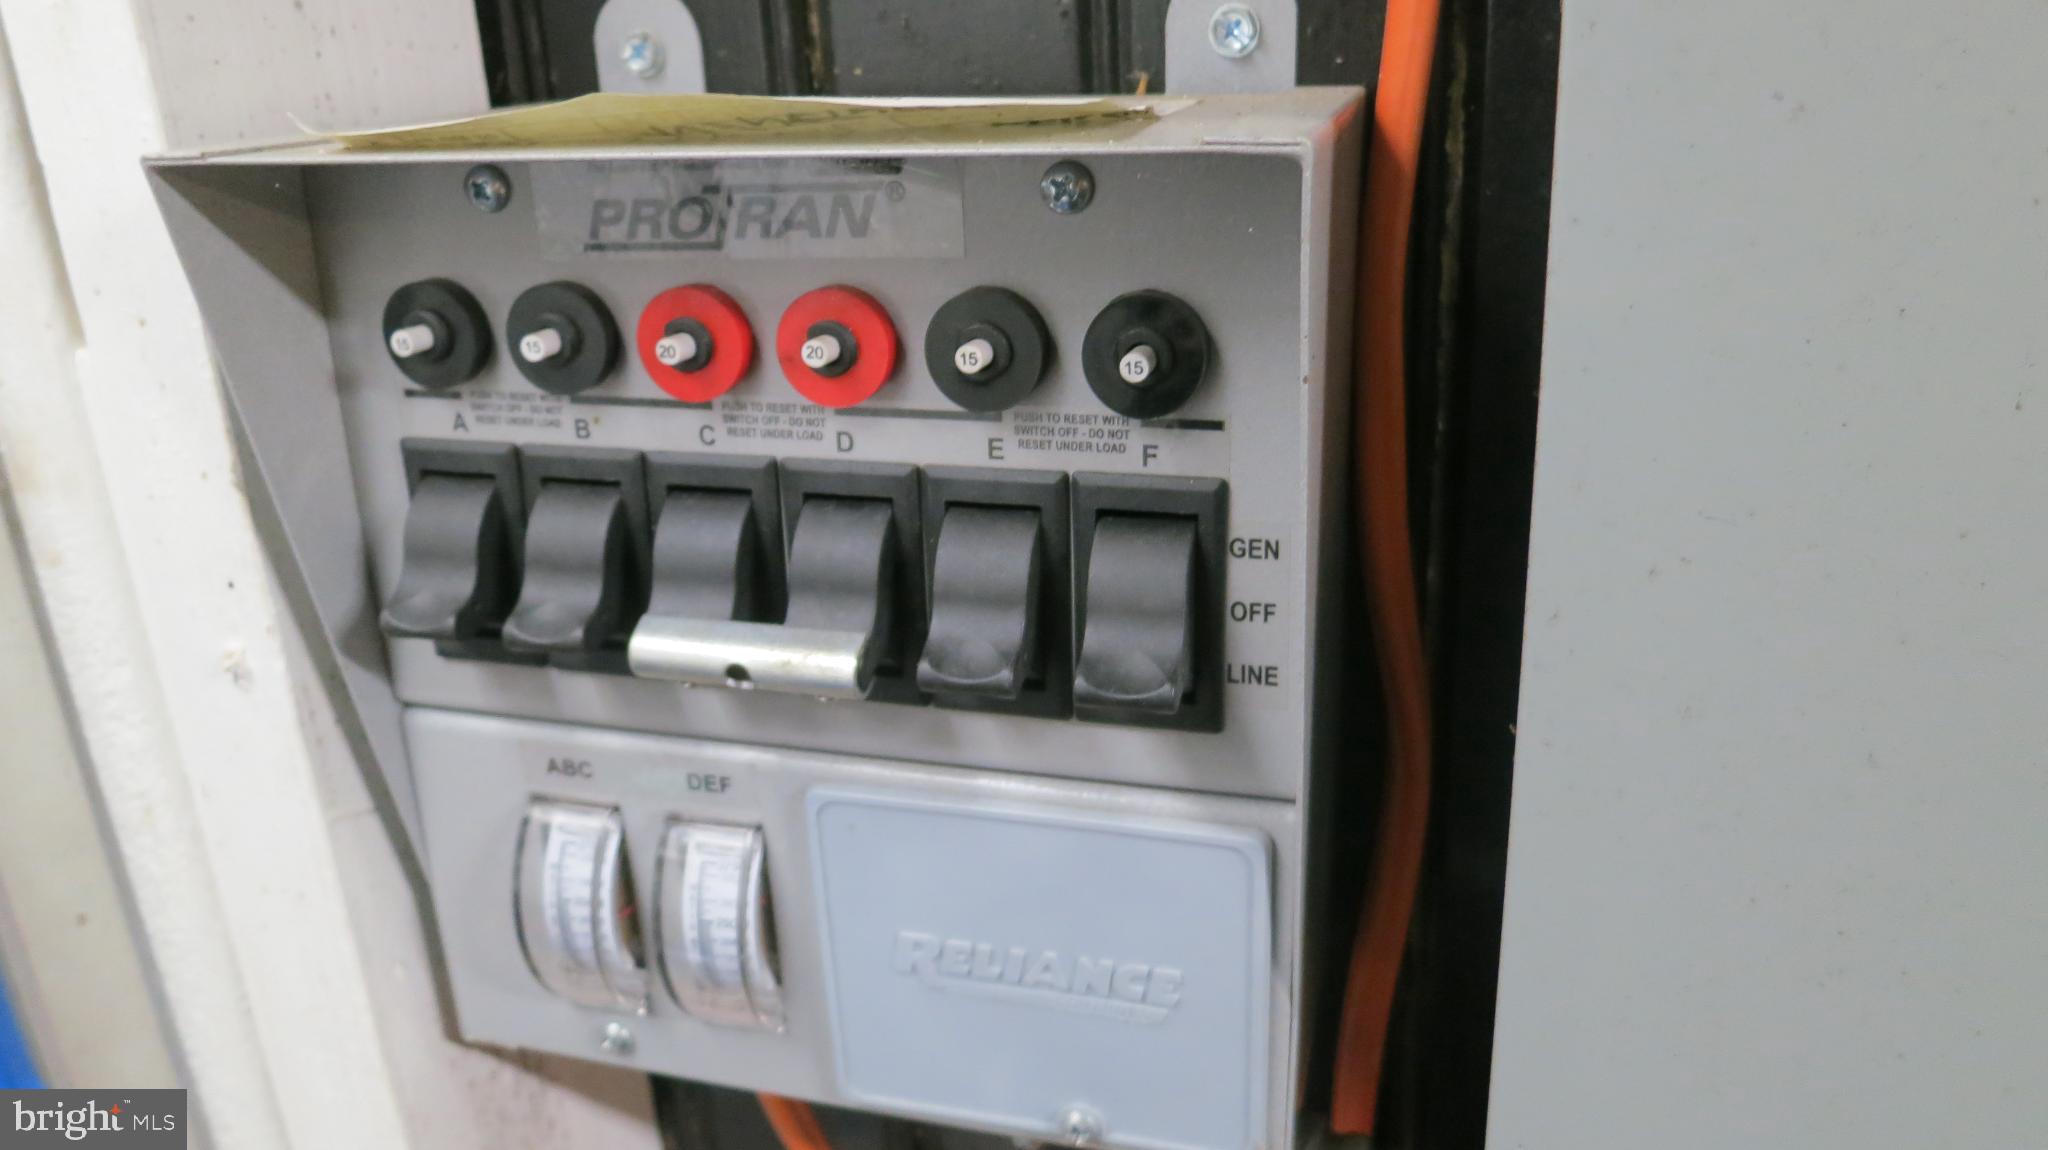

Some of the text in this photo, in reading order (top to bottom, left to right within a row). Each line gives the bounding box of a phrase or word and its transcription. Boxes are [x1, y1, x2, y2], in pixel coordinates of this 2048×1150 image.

[525, 341, 542, 354] 15
[659, 344, 677, 360] 20
[805, 345, 824, 360] 20
[960, 352, 978, 367] 15
[1125, 361, 1145, 376] 15
[453, 412, 469, 432] A
[761, 416, 780, 427] OFF
[789, 417, 803, 427] DO
[806, 417, 826, 428] NOT
[1014, 411, 1130, 427] PUSH TO RESET WITH
[574, 419, 591, 440] B
[699, 425, 716, 446] C
[727, 427, 823, 441] RESET UNDER LOAD
[1014, 425, 1055, 437] SWITCH
[1058, 427, 1079, 438] OFF
[1088, 428, 1104, 440] DO
[1108, 429, 1130, 440] NOT
[836, 432, 853, 452] D
[988, 438, 1003, 459] E
[1018, 438, 1127, 454] RESET UNDER LOAD
[1142, 445, 1159, 467] F
[1229, 537, 1280, 560] GEN
[1230, 602, 1276, 623] OFF
[1226, 663, 1279, 687] LINE
[546, 757, 594, 779] ABC
[686, 773, 731, 794] DEF
[896, 929, 1184, 1008] RELIANCE
